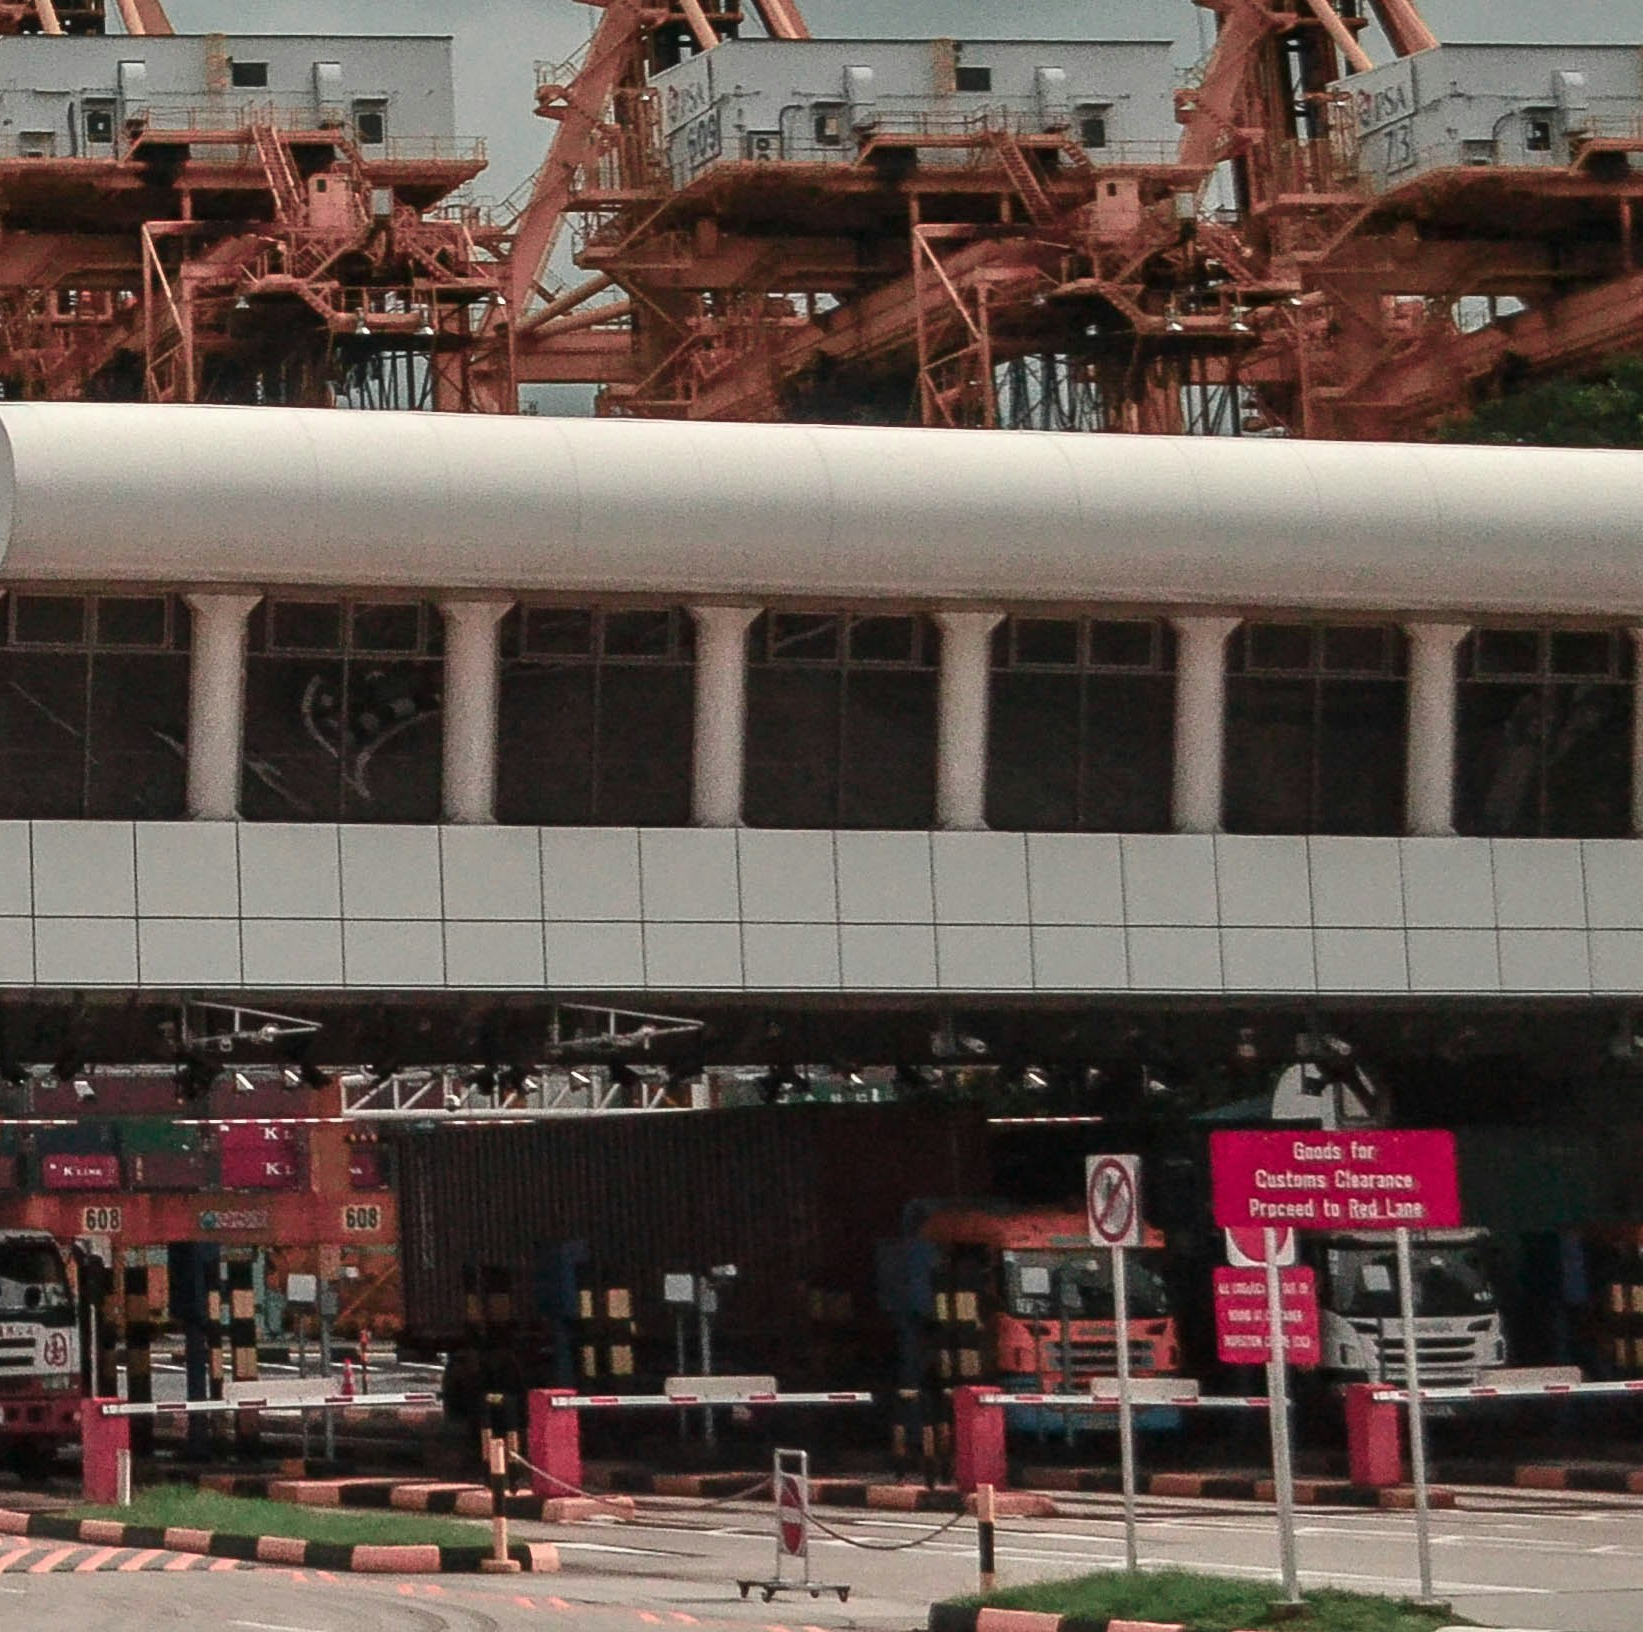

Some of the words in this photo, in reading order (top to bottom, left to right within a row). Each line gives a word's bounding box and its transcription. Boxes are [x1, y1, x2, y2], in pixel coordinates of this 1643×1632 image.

[1293, 1141, 1342, 1161] Goods
[1351, 1141, 1375, 1161] for
[1254, 1169, 1327, 1190] Customs
[1334, 1170, 1414, 1190] Clearance
[345, 1207, 380, 1229] 608
[1248, 1198, 1315, 1218] Proceed
[1323, 1199, 1341, 1218] to
[1349, 1198, 1379, 1218] Red
[1385, 1199, 1424, 1218] Lane
[86, 1209, 121, 1230] 608
